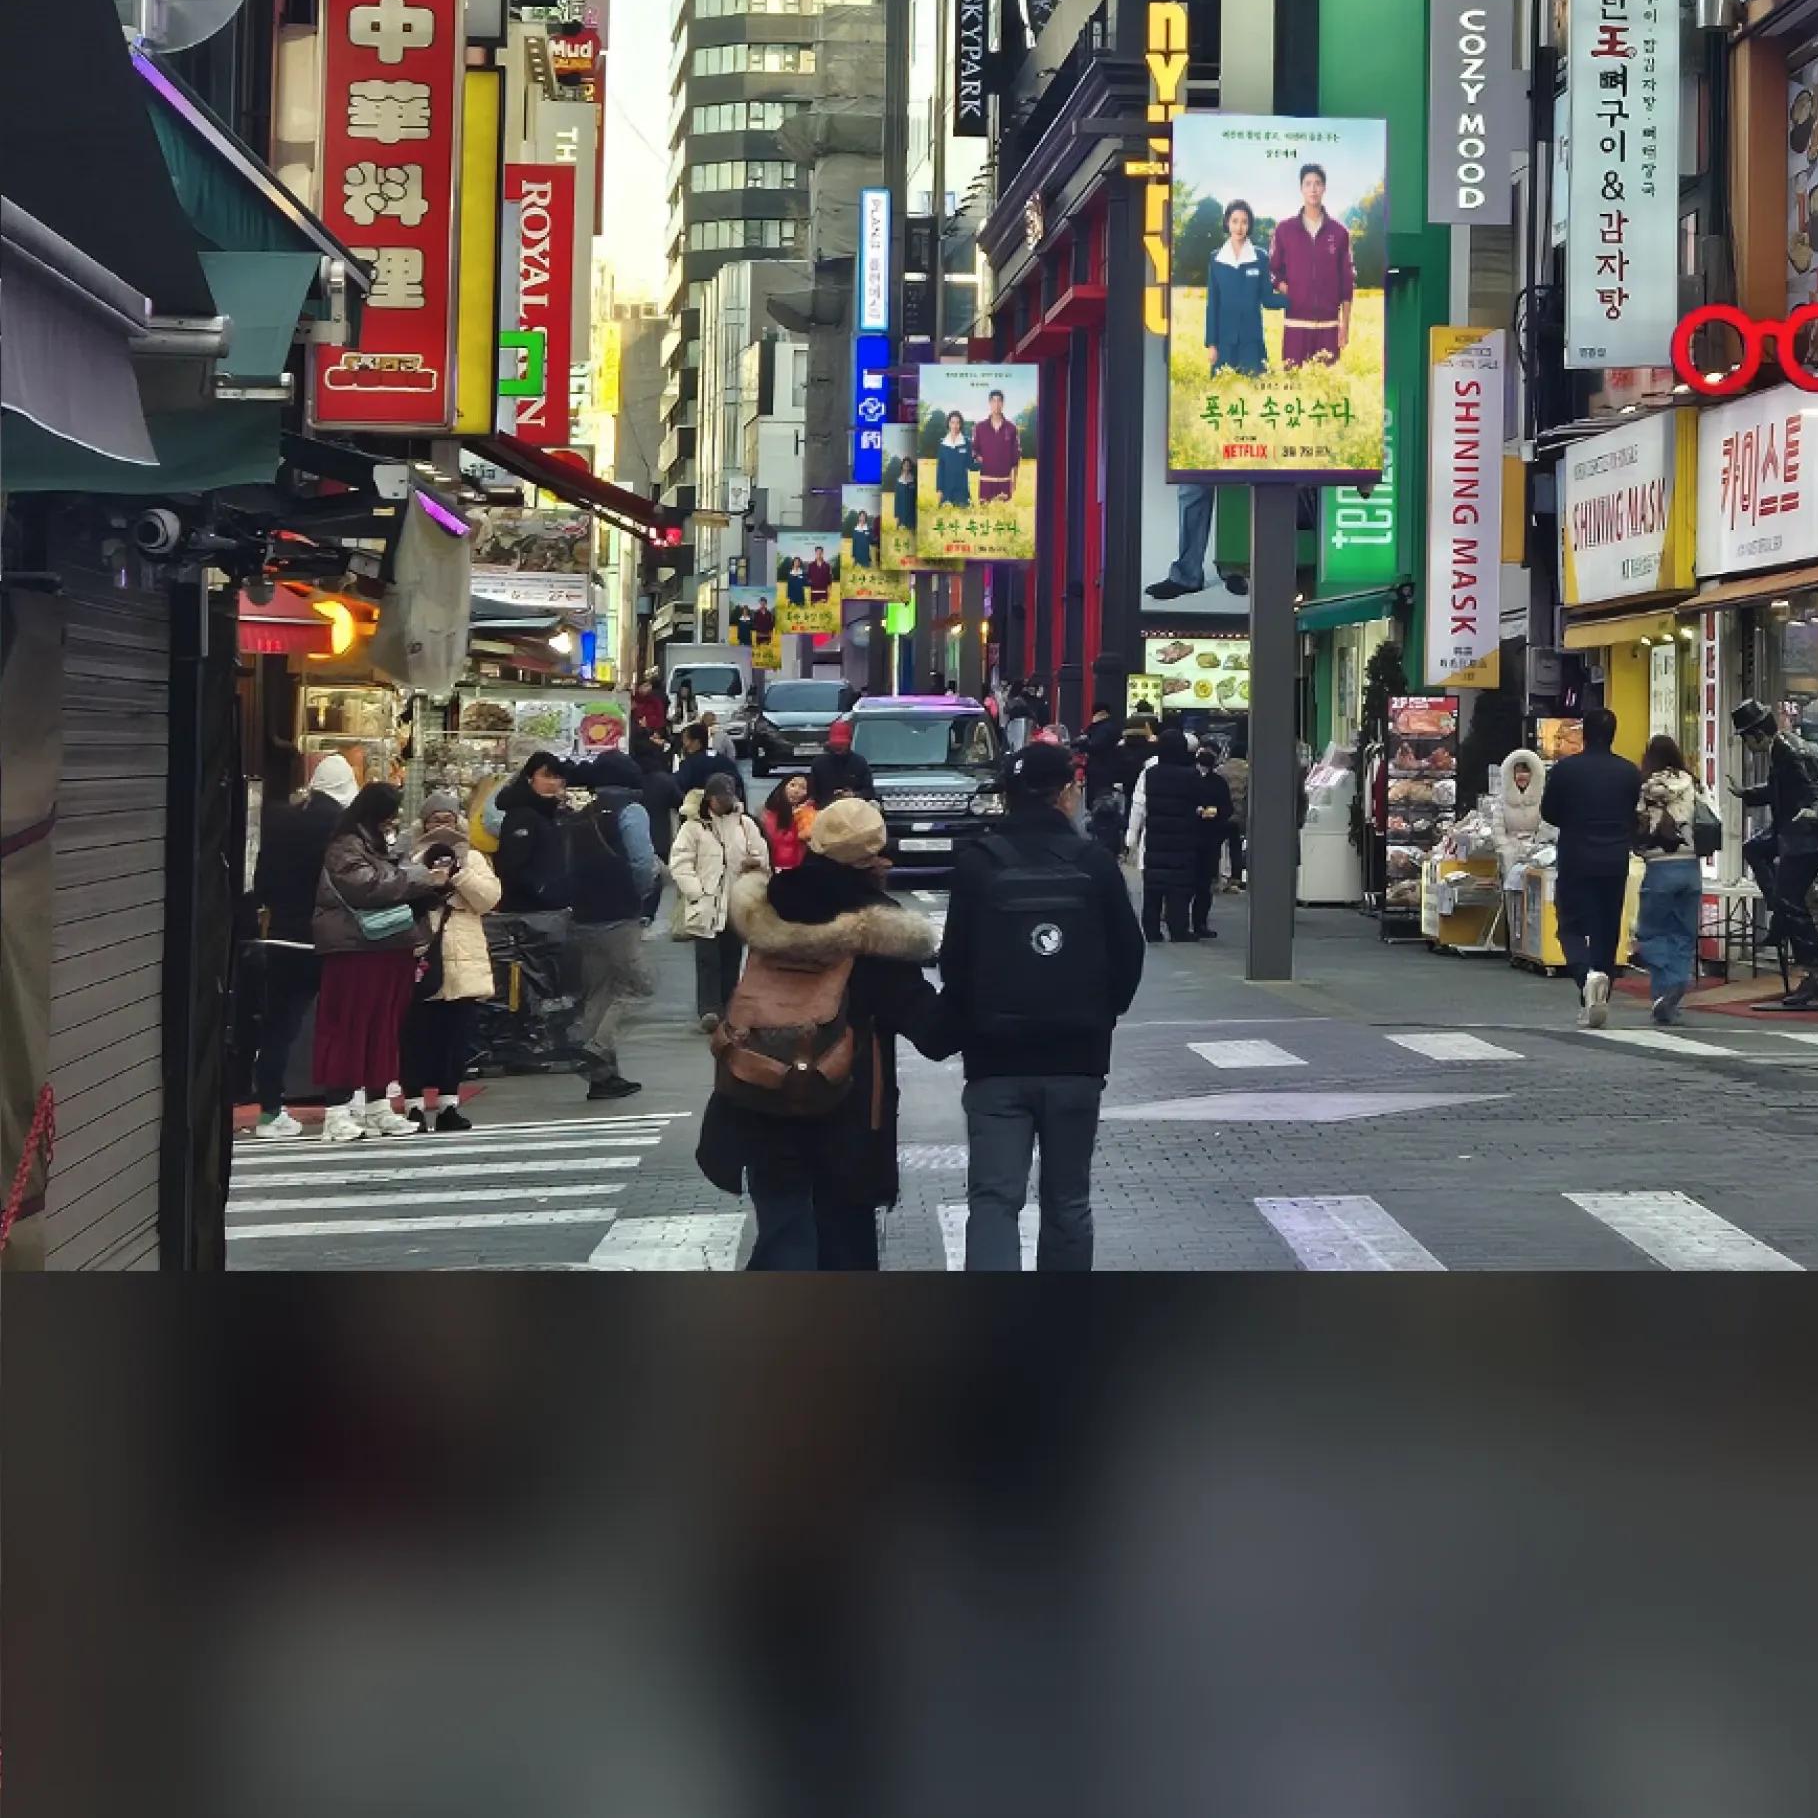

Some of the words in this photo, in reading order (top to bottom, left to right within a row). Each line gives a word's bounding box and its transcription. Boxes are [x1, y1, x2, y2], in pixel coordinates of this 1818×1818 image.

[550, 39, 592, 58] Mud
[1458, 9, 1487, 104] COZY
[1457, 113, 1486, 209] MOOD
[1601, 171, 1625, 200] &
[520, 180, 552, 319] ROYAL
[1596, 210, 1630, 320] 감자탕
[1223, 443, 1267, 460] NETFLIX
[1453, 381, 1481, 525] SHINING
[1721, 415, 1802, 530] 카이스트
[1573, 488, 1624, 552] SHINING
[1628, 478, 1667, 539] MASK
[1450, 540, 1479, 635] MASK
